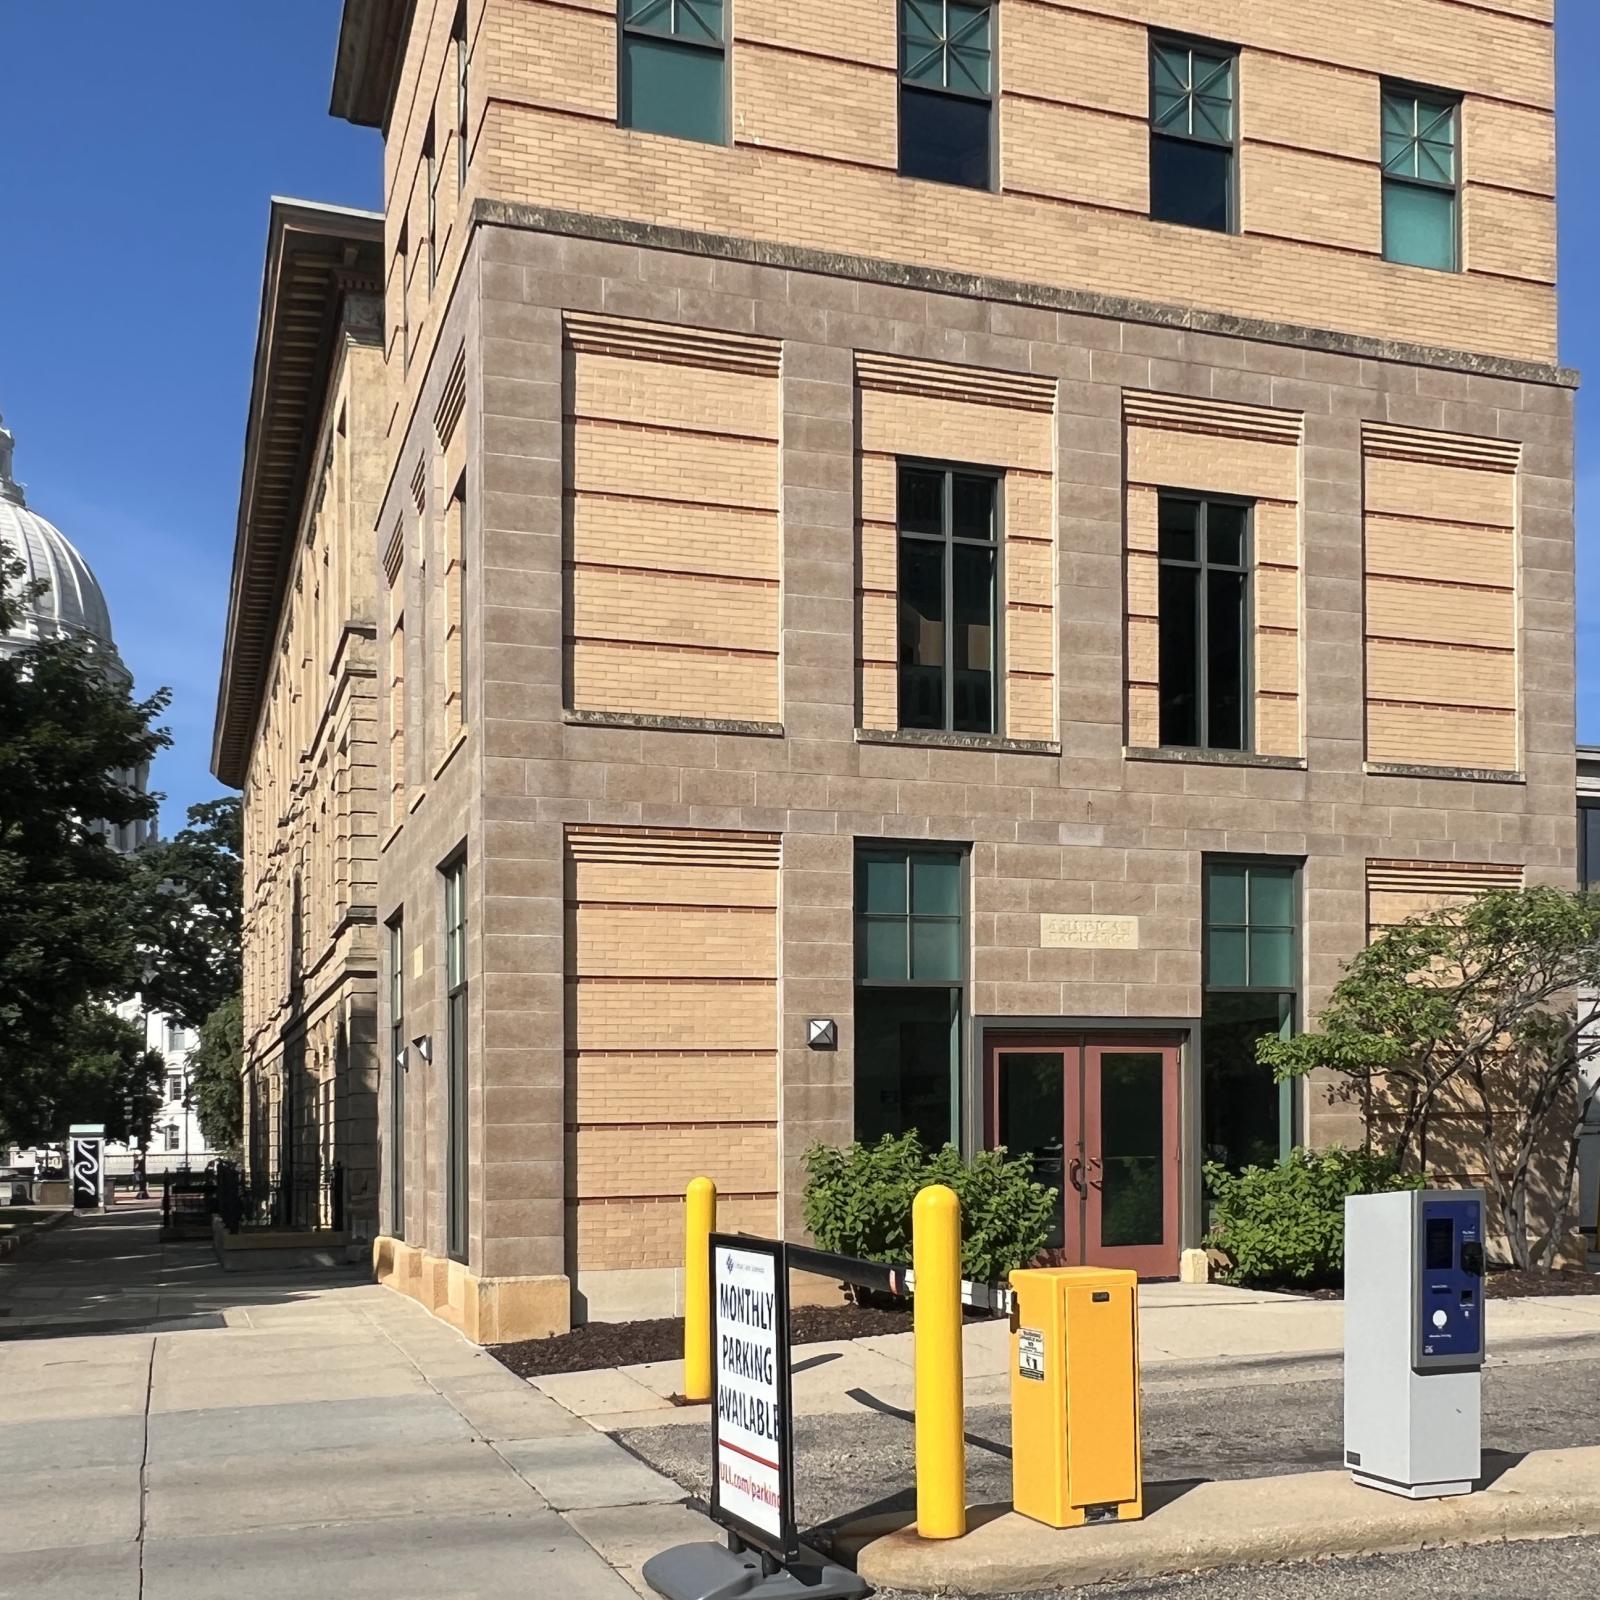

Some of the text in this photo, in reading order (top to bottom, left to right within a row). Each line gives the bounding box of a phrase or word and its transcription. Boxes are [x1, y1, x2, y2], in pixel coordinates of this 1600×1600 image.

[720, 1282, 774, 1331] MONTHLY
[722, 1334, 773, 1385] PARKING
[719, 1384, 780, 1442] AVAILABLE
